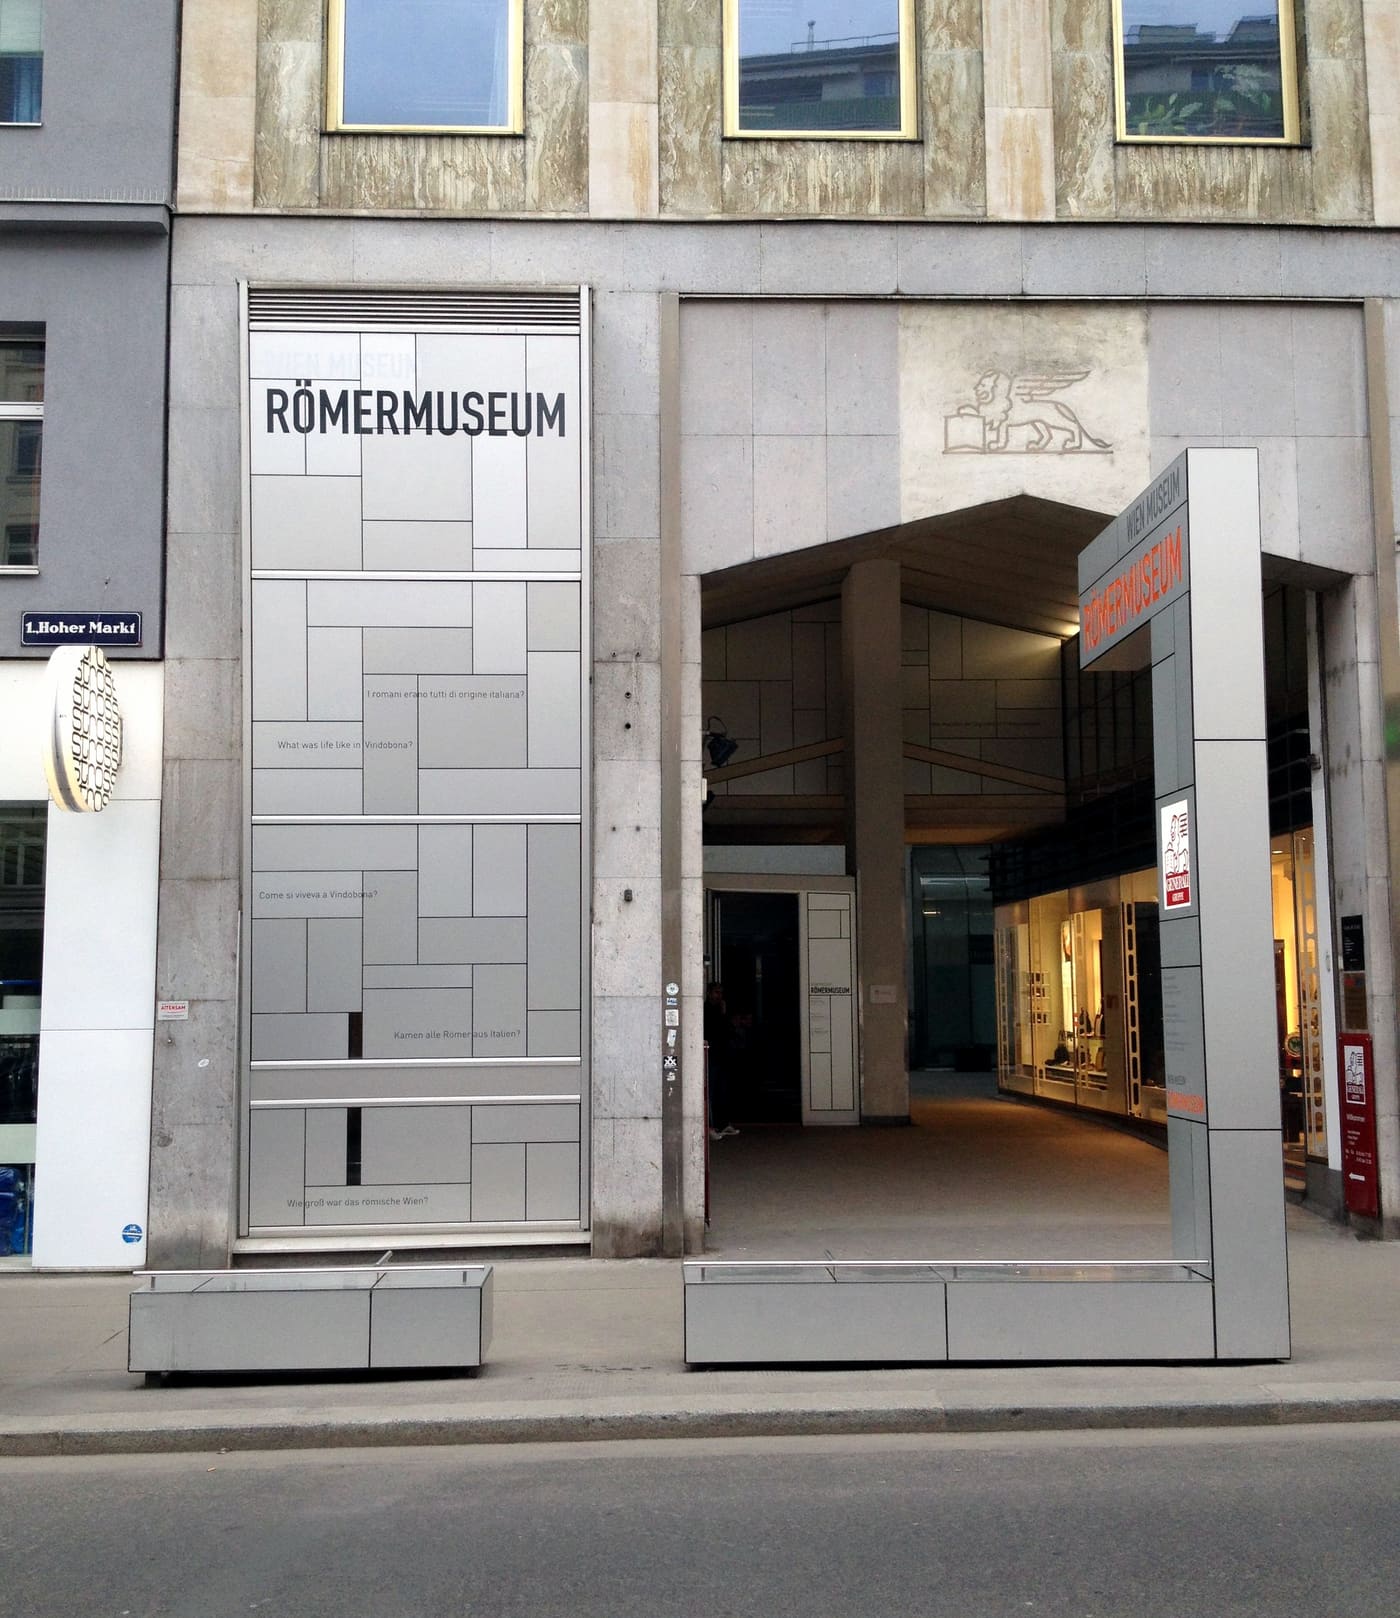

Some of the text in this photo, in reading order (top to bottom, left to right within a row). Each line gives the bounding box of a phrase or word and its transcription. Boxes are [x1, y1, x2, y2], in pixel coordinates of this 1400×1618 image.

[266, 379, 566, 437] RÖMERMUSEUM
[1126, 467, 1180, 543] WIEN MUSEUM
[1083, 525, 1183, 654] RÖMERMUSEUM
[88, 621, 136, 634] Markt
[372, 690, 402, 698] romani
[430, 690, 447, 698] tutti
[449, 690, 457, 698] di
[459, 690, 487, 700] origine
[489, 690, 525, 699] italiana?
[278, 741, 413, 749] What was life like in Vindobona?
[259, 891, 284, 899] Come
[330, 890, 378, 899] Vindobona?
[810, 985, 850, 994] RÖMERMUSEUM
[394, 1031, 424, 1039] Kamen
[425, 1030, 441, 1039] alle
[490, 1029, 521, 1038] Italien?
[287, 1199, 303, 1207] Wie
[326, 1199, 342, 1207] war
[344, 1197, 360, 1206] das
[403, 1196, 429, 1205] Wien?
